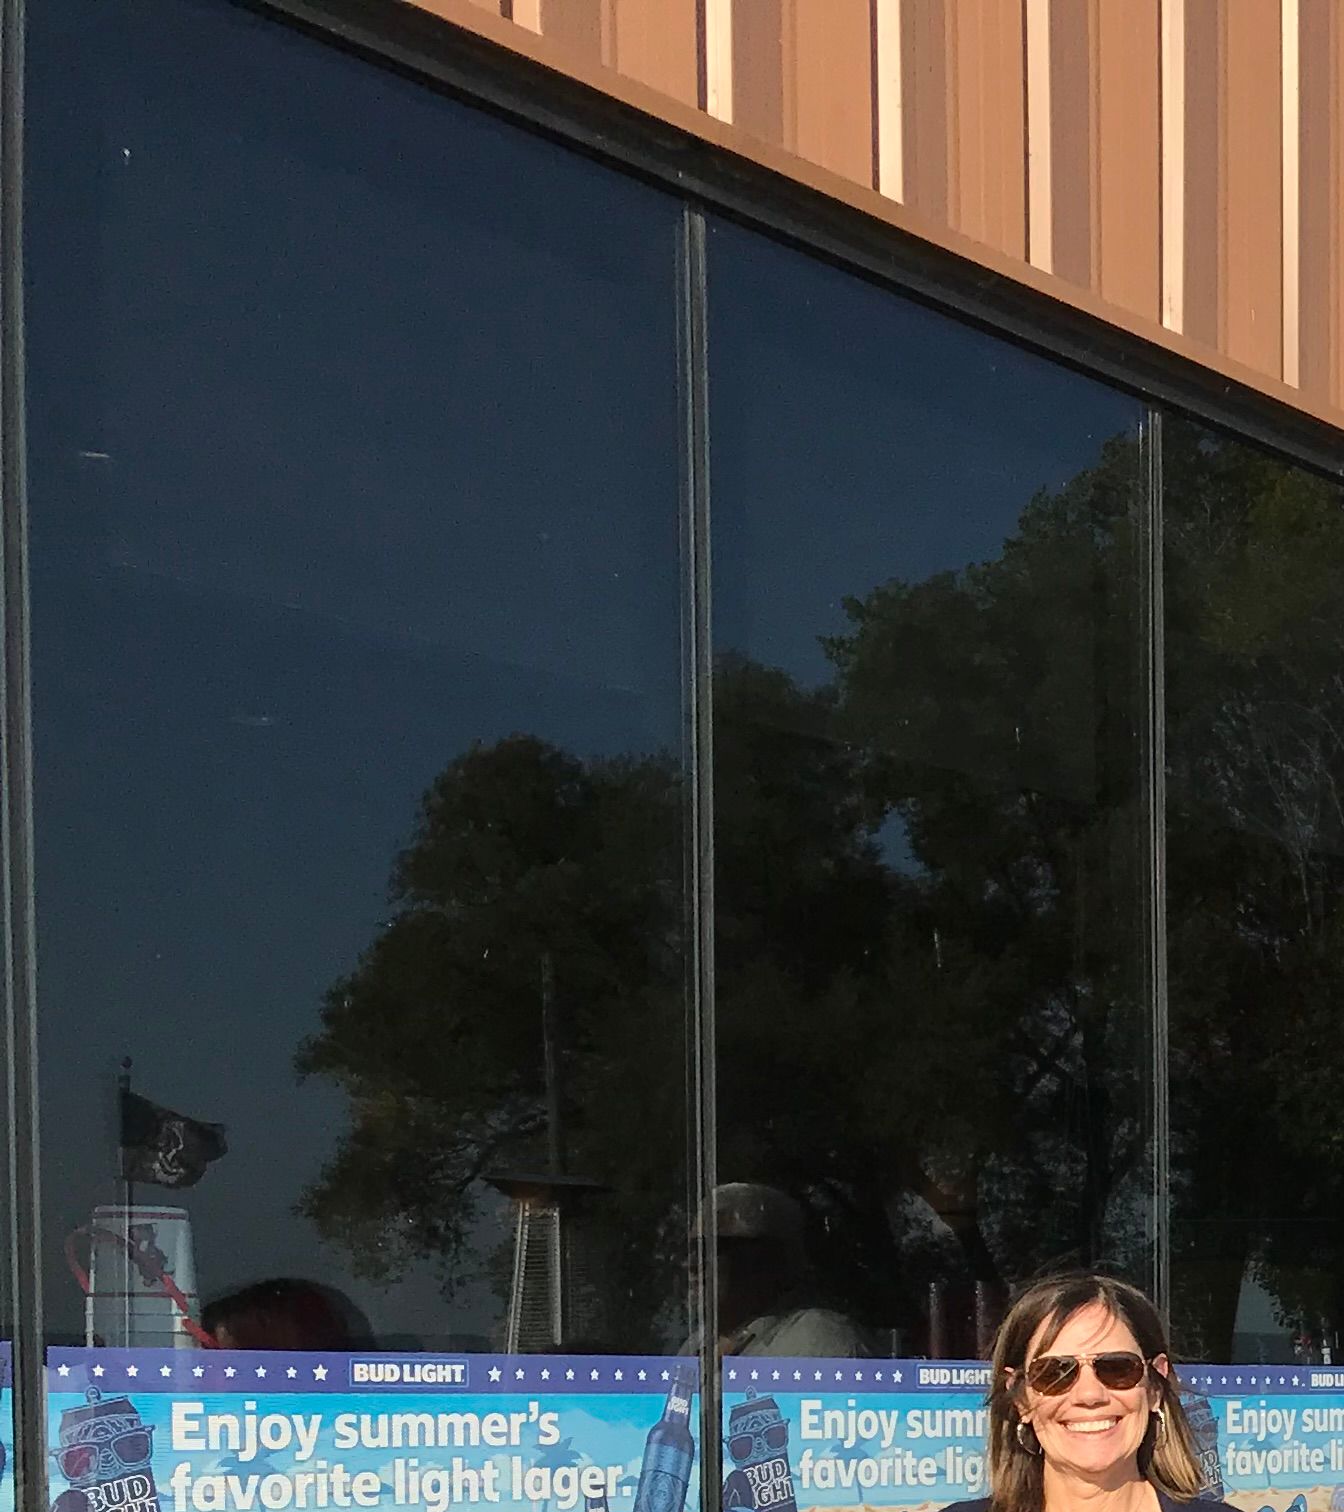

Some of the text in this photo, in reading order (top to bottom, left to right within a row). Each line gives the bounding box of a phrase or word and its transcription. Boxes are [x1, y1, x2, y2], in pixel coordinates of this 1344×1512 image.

[354, 1364, 464, 1383] BUD LIGHT
[920, 1368, 993, 1386] BUD LIGHT
[1311, 1373, 1334, 1387] BUD
[171, 1400, 560, 1461] Enjoy summer's
[800, 1399, 898, 1449] Enjoy
[1226, 1400, 1296, 1442] Enjoy
[800, 1449, 937, 1489] favorite
[1226, 1442, 1324, 1476] favorite
[82, 1475, 150, 1512] BUD
[170, 1461, 380, 1512] favorite
[512, 1456, 632, 1510] lager.
